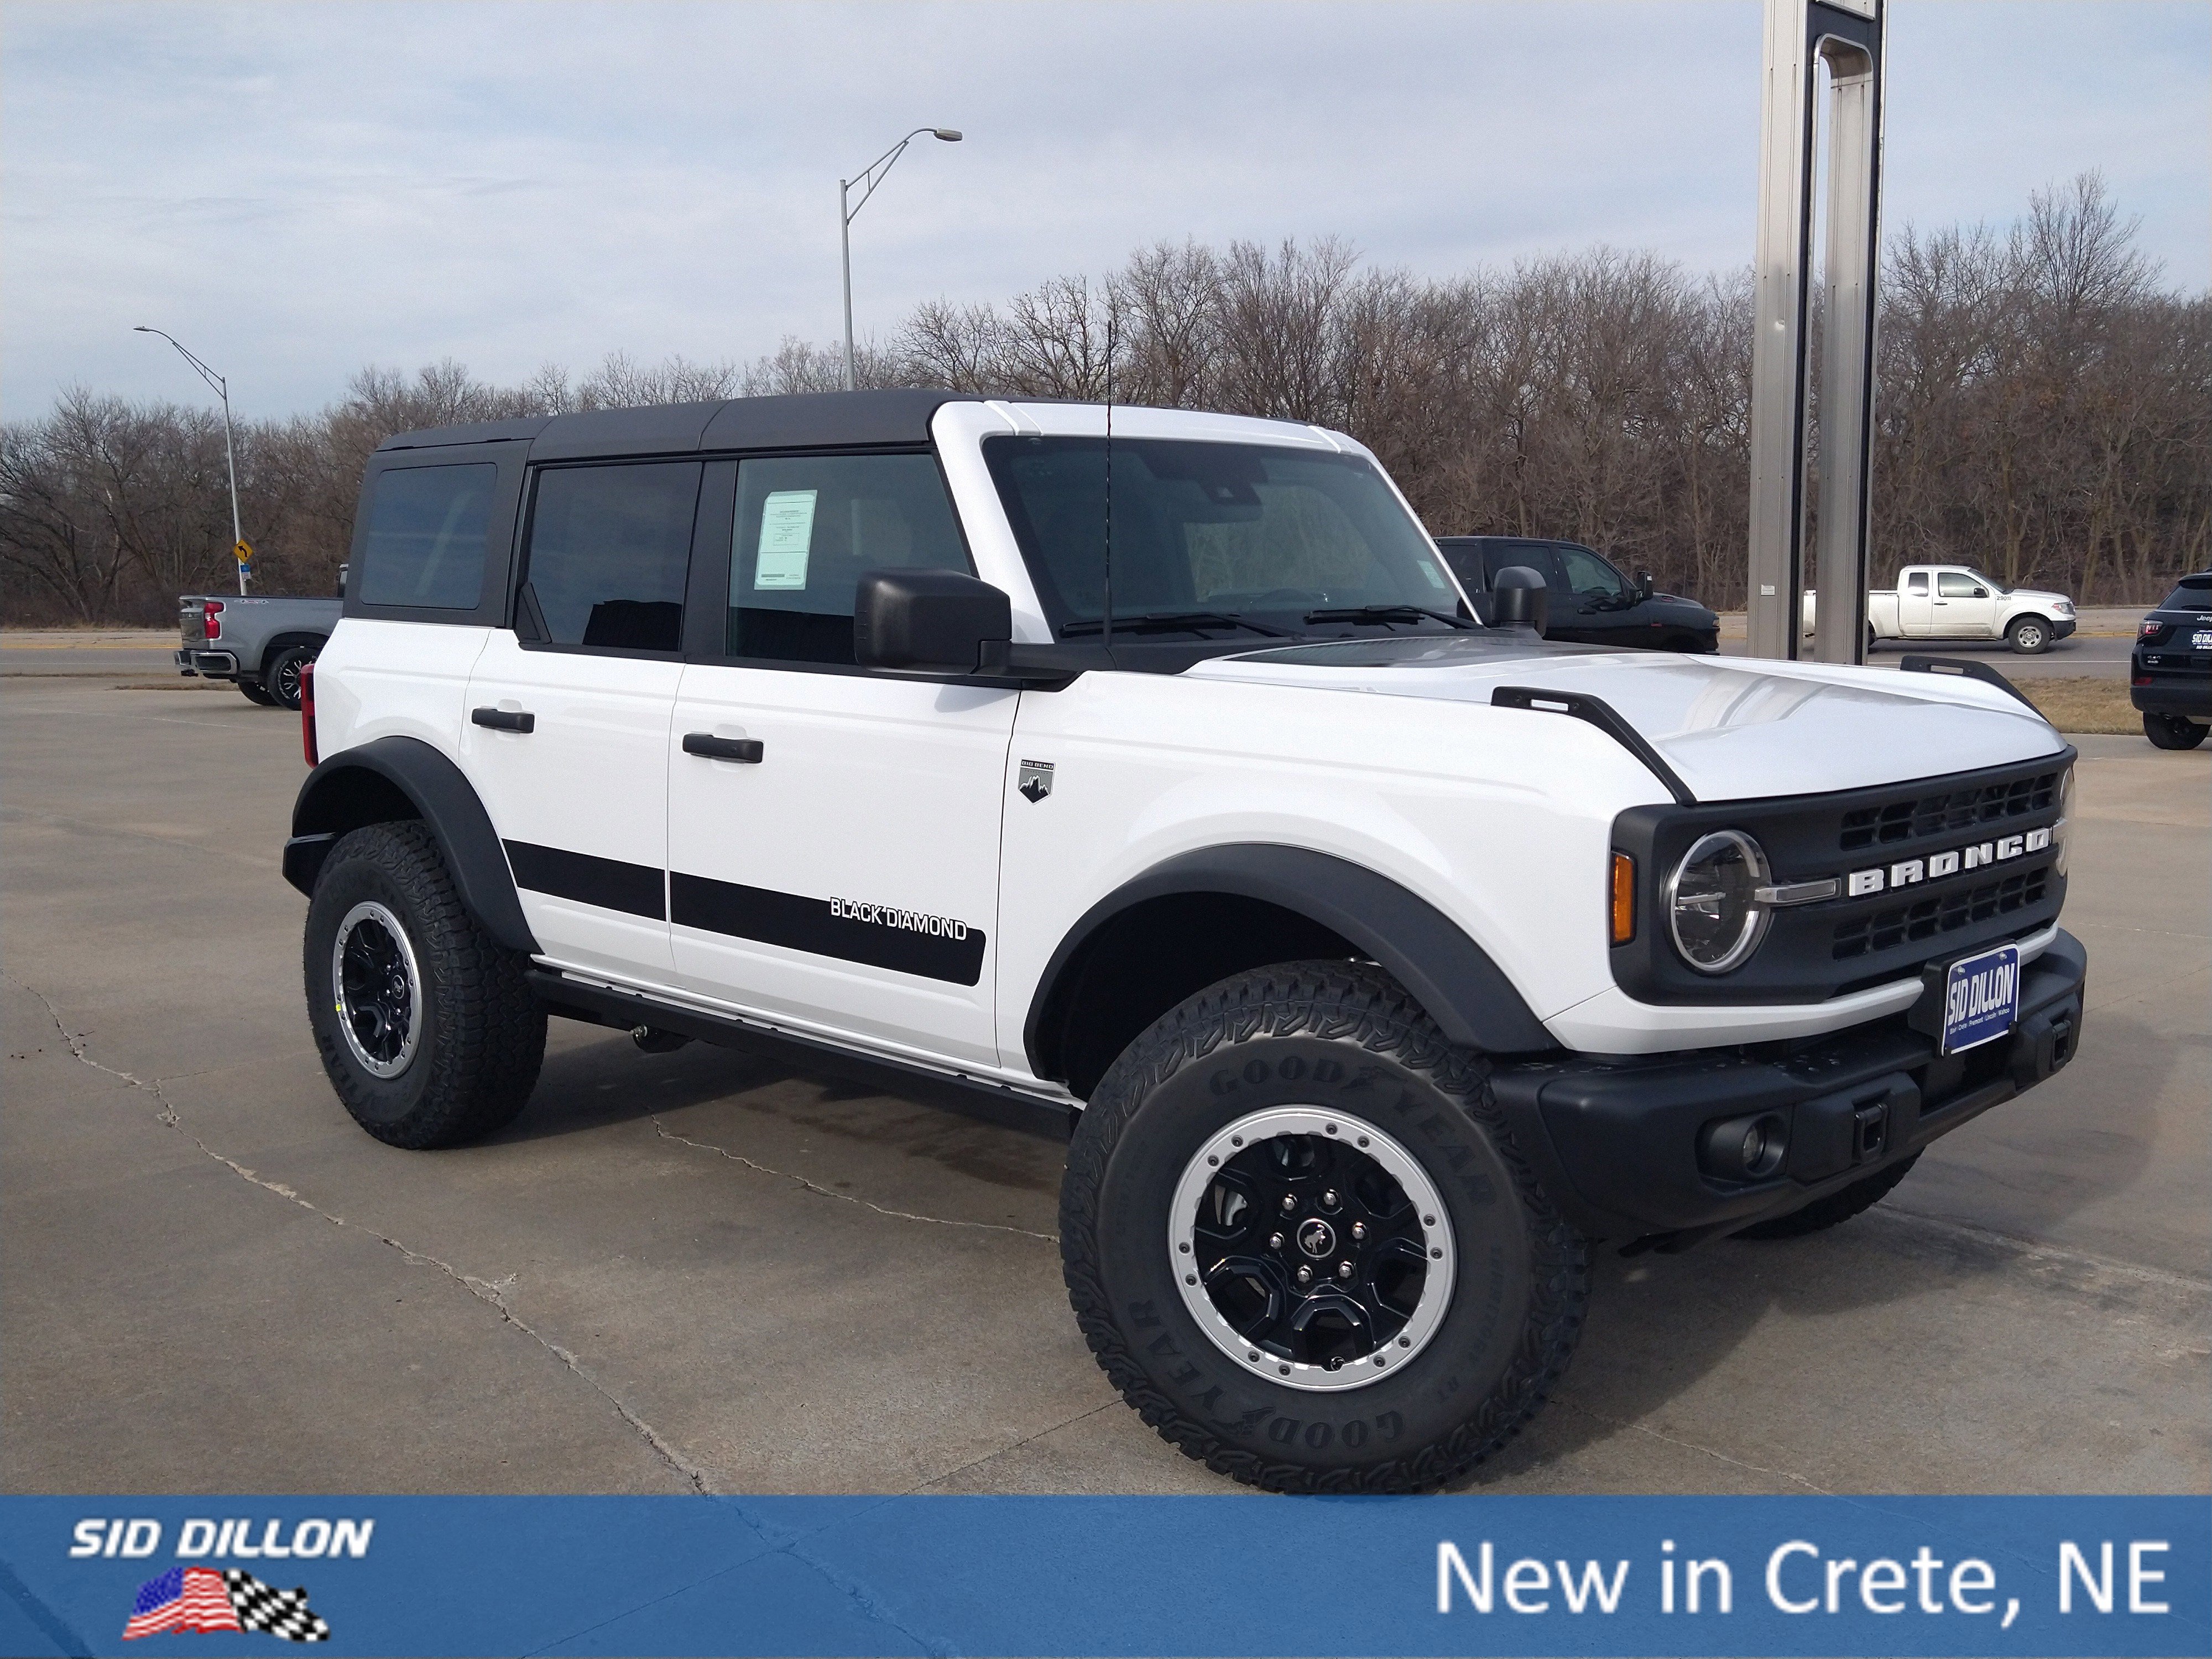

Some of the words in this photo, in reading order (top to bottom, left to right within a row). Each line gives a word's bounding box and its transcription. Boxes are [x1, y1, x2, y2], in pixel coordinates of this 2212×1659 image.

[2192, 634, 2202, 643] SID
[1849, 828, 2049, 896] BRONCO
[831, 897, 883, 925] BLACK
[886, 907, 968, 941] DIAMOND
[1948, 978, 1969, 1026] SID
[1968, 963, 2015, 1018] DILLON
